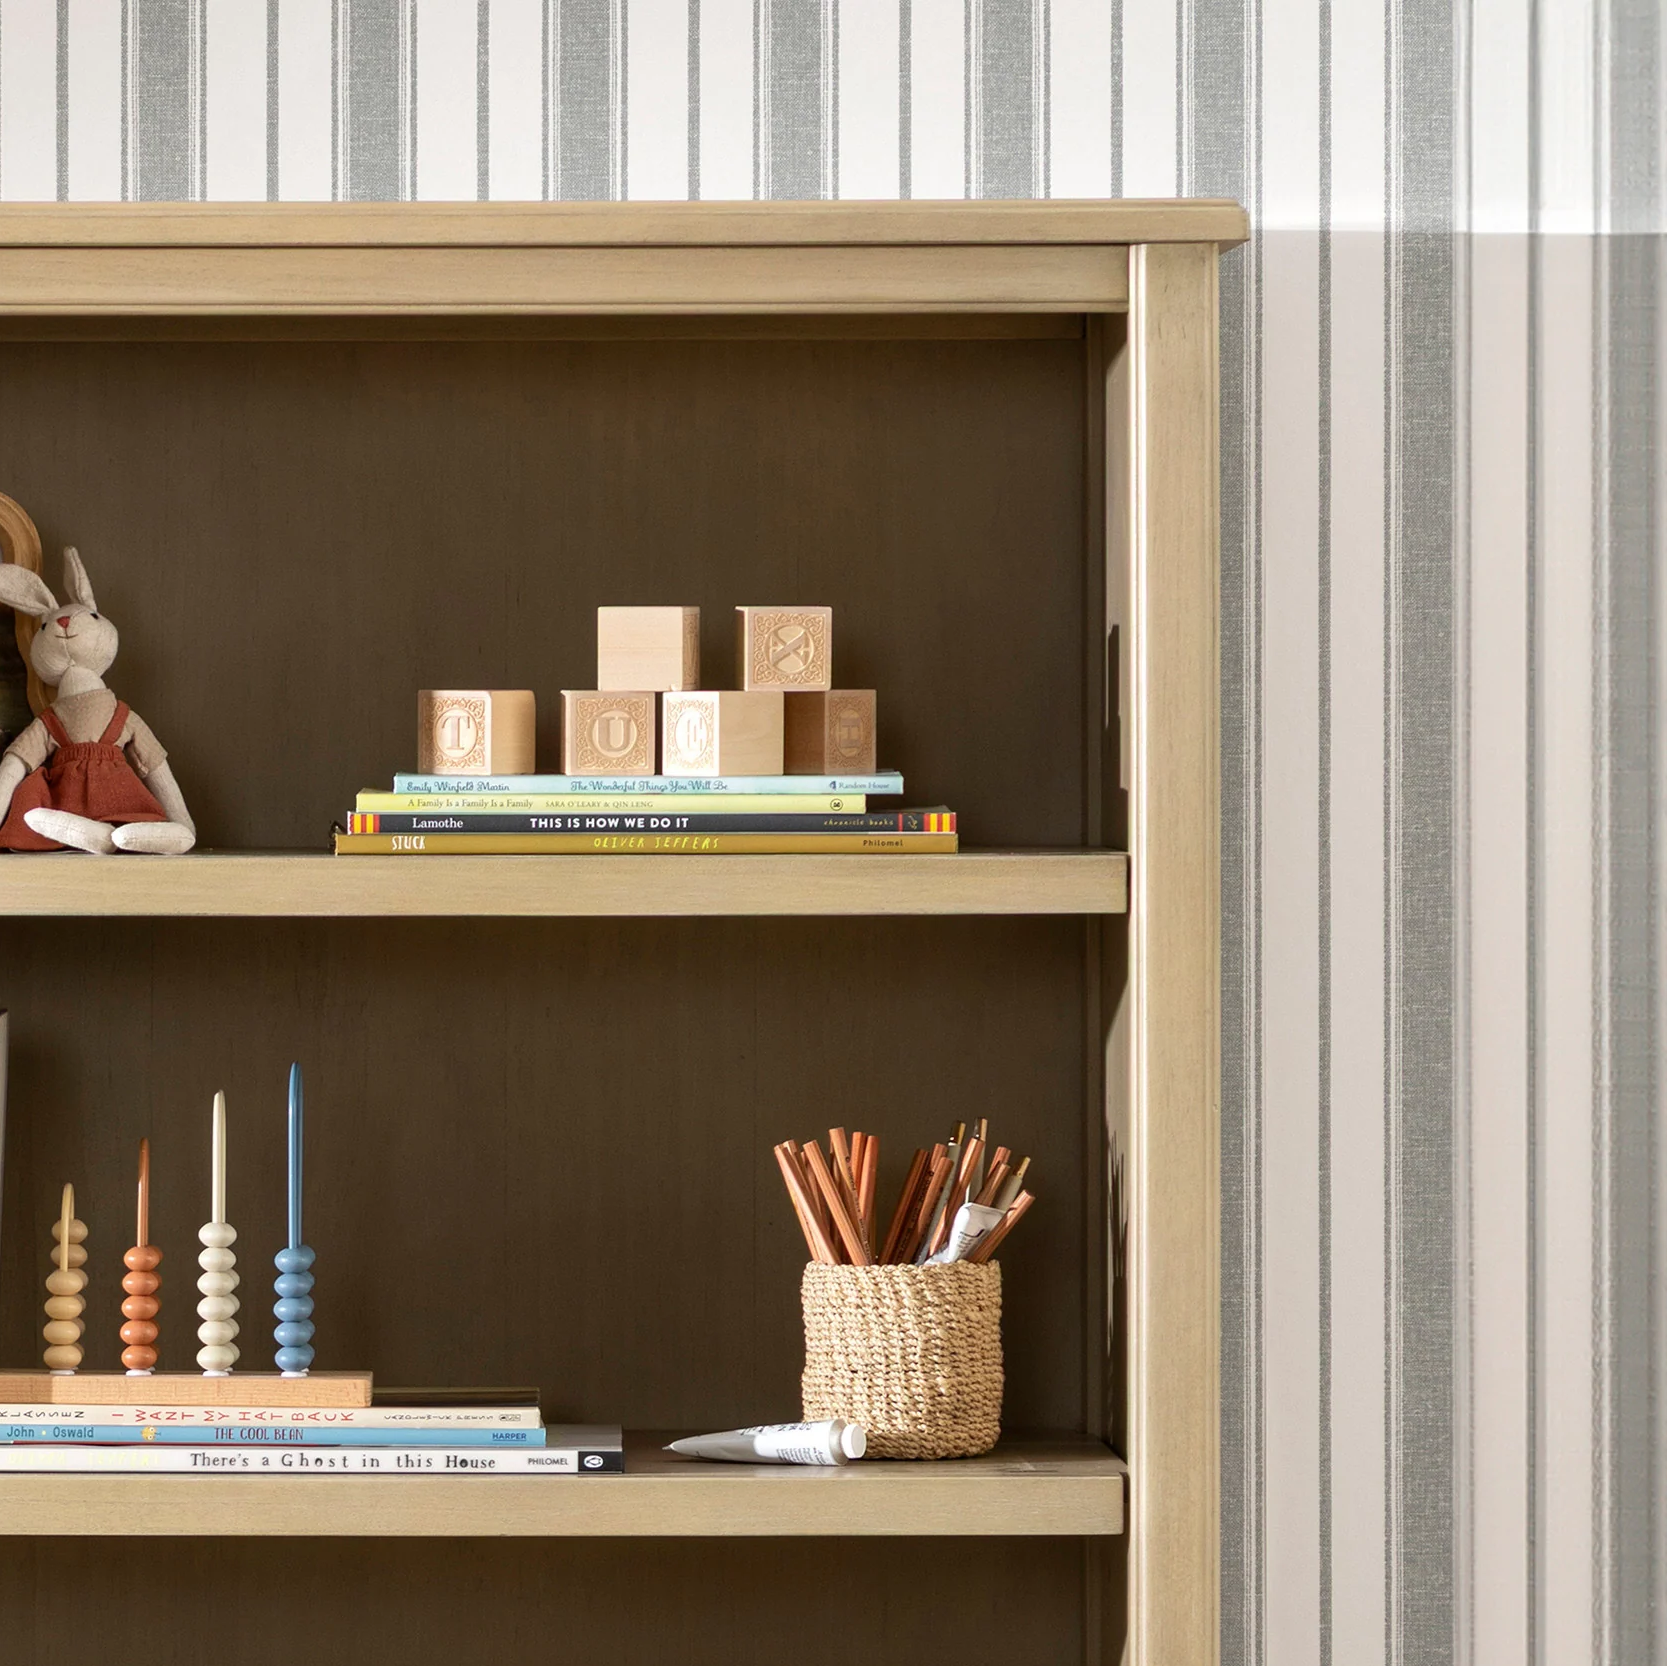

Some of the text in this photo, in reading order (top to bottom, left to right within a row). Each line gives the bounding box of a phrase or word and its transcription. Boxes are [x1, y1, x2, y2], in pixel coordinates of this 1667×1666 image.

[441, 715, 471, 751] T
[594, 716, 633, 752] U
[406, 780, 510, 793] Emily Winfield Martin
[571, 780, 728, 794] The Wonderful Things You Will Be
[839, 781, 890, 790] Random House
[407, 799, 416, 808] A
[417, 799, 444, 810] Family
[446, 799, 454, 808] Is
[461, 799, 489, 810] Family
[491, 799, 498, 808] Is
[506, 799, 534, 810] Family
[546, 801, 654, 810] SARA O'LEARY & QIN LENG
[412, 817, 464, 829] Lamothe
[530, 817, 689, 829] THIS IS HOW WE DO IT
[869, 818, 894, 827] books
[391, 835, 426, 850] STUCK
[593, 836, 720, 850] OLIVER JEFFERS
[862, 839, 904, 848] Philomel
[134, 1409, 195, 1422] WANT
[203, 1410, 231, 1422] MY
[238, 1410, 284, 1422] HAT
[290, 1410, 355, 1422] BACK
[6, 1426, 94, 1439] John Oswald
[214, 1427, 304, 1441] THE COOL BEAN
[492, 1432, 527, 1441] HARPER
[190, 1453, 496, 1469] There's a Ghost in this House
[527, 1457, 570, 1466] PHILOMEL
